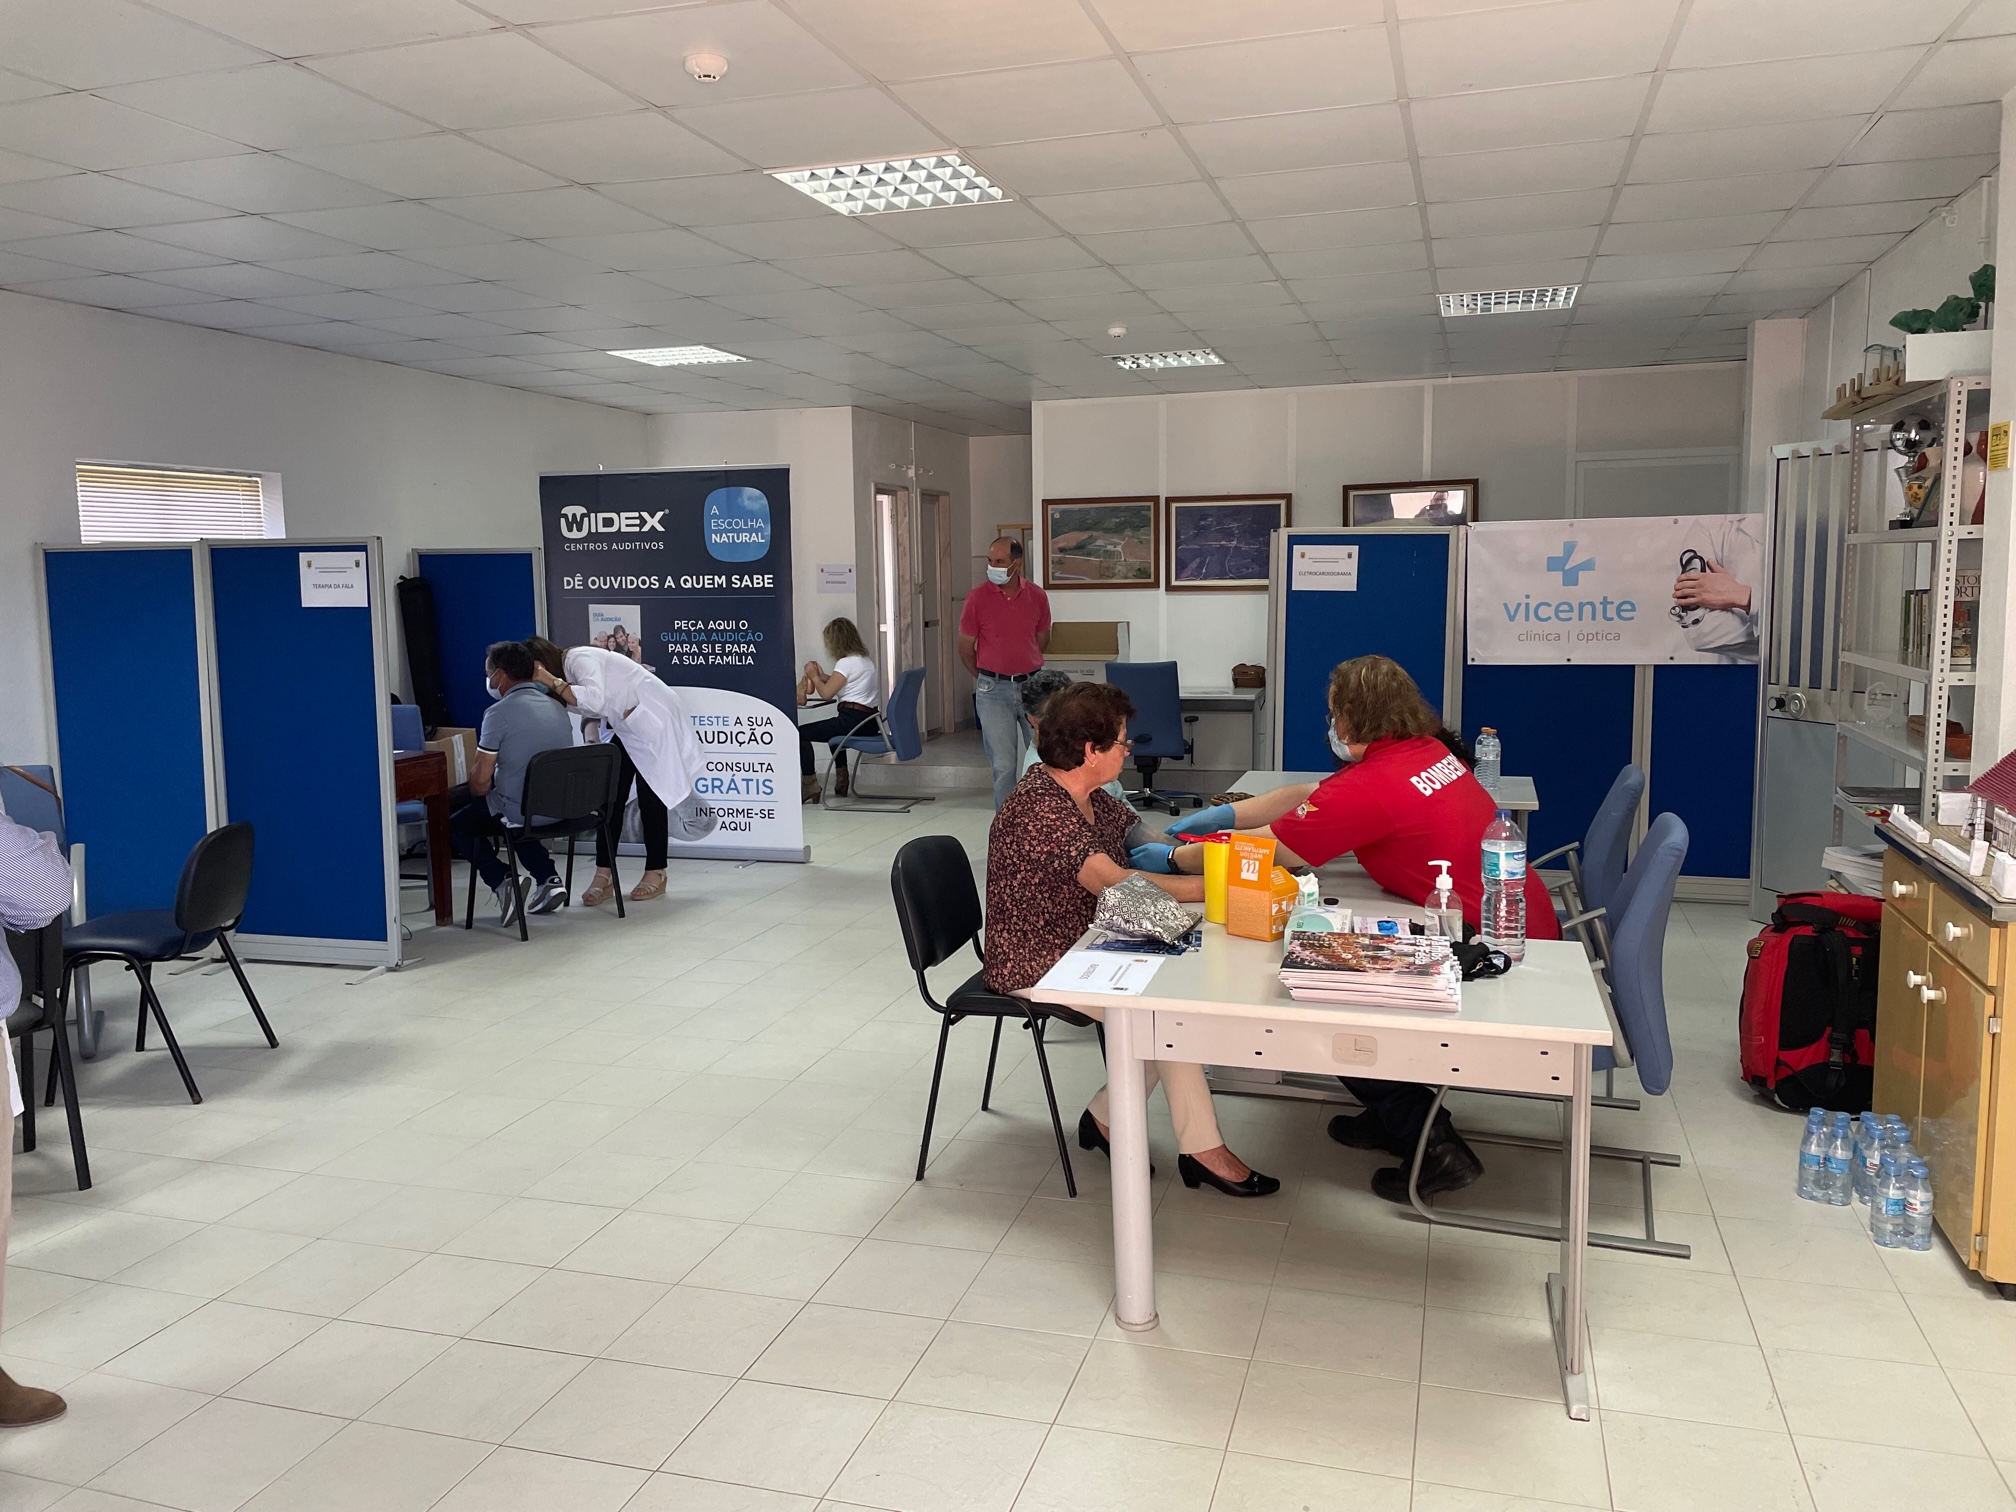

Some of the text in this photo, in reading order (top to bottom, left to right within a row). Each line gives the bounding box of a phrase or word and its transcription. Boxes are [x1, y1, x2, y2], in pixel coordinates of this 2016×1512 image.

[710, 505, 719, 515] A
[560, 505, 666, 539] WIDEX
[711, 518, 765, 529] ESCOLHA
[711, 533, 766, 543] NATURAL
[564, 542, 665, 551] CENTROS AUDITIVOS
[563, 573, 774, 590] DÊ OUVIDOS A QUEM SABE
[1503, 594, 1637, 622] vicente
[674, 620, 748, 631] PEÇA AQUI O
[660, 630, 764, 642] GUIA DA AUDIÇÃO
[1518, 629, 1621, 643] clínica óptica
[668, 643, 756, 653] PARA SI E PARA
[671, 653, 755, 665] A SUA FAMÍLIA
[690, 715, 774, 727] TESTE A SUA
[706, 761, 775, 773] CONSULTA
[694, 774, 774, 796] GRÁTIS
[695, 807, 775, 819] INFORME-SE
[719, 821, 751, 832] AQUI
